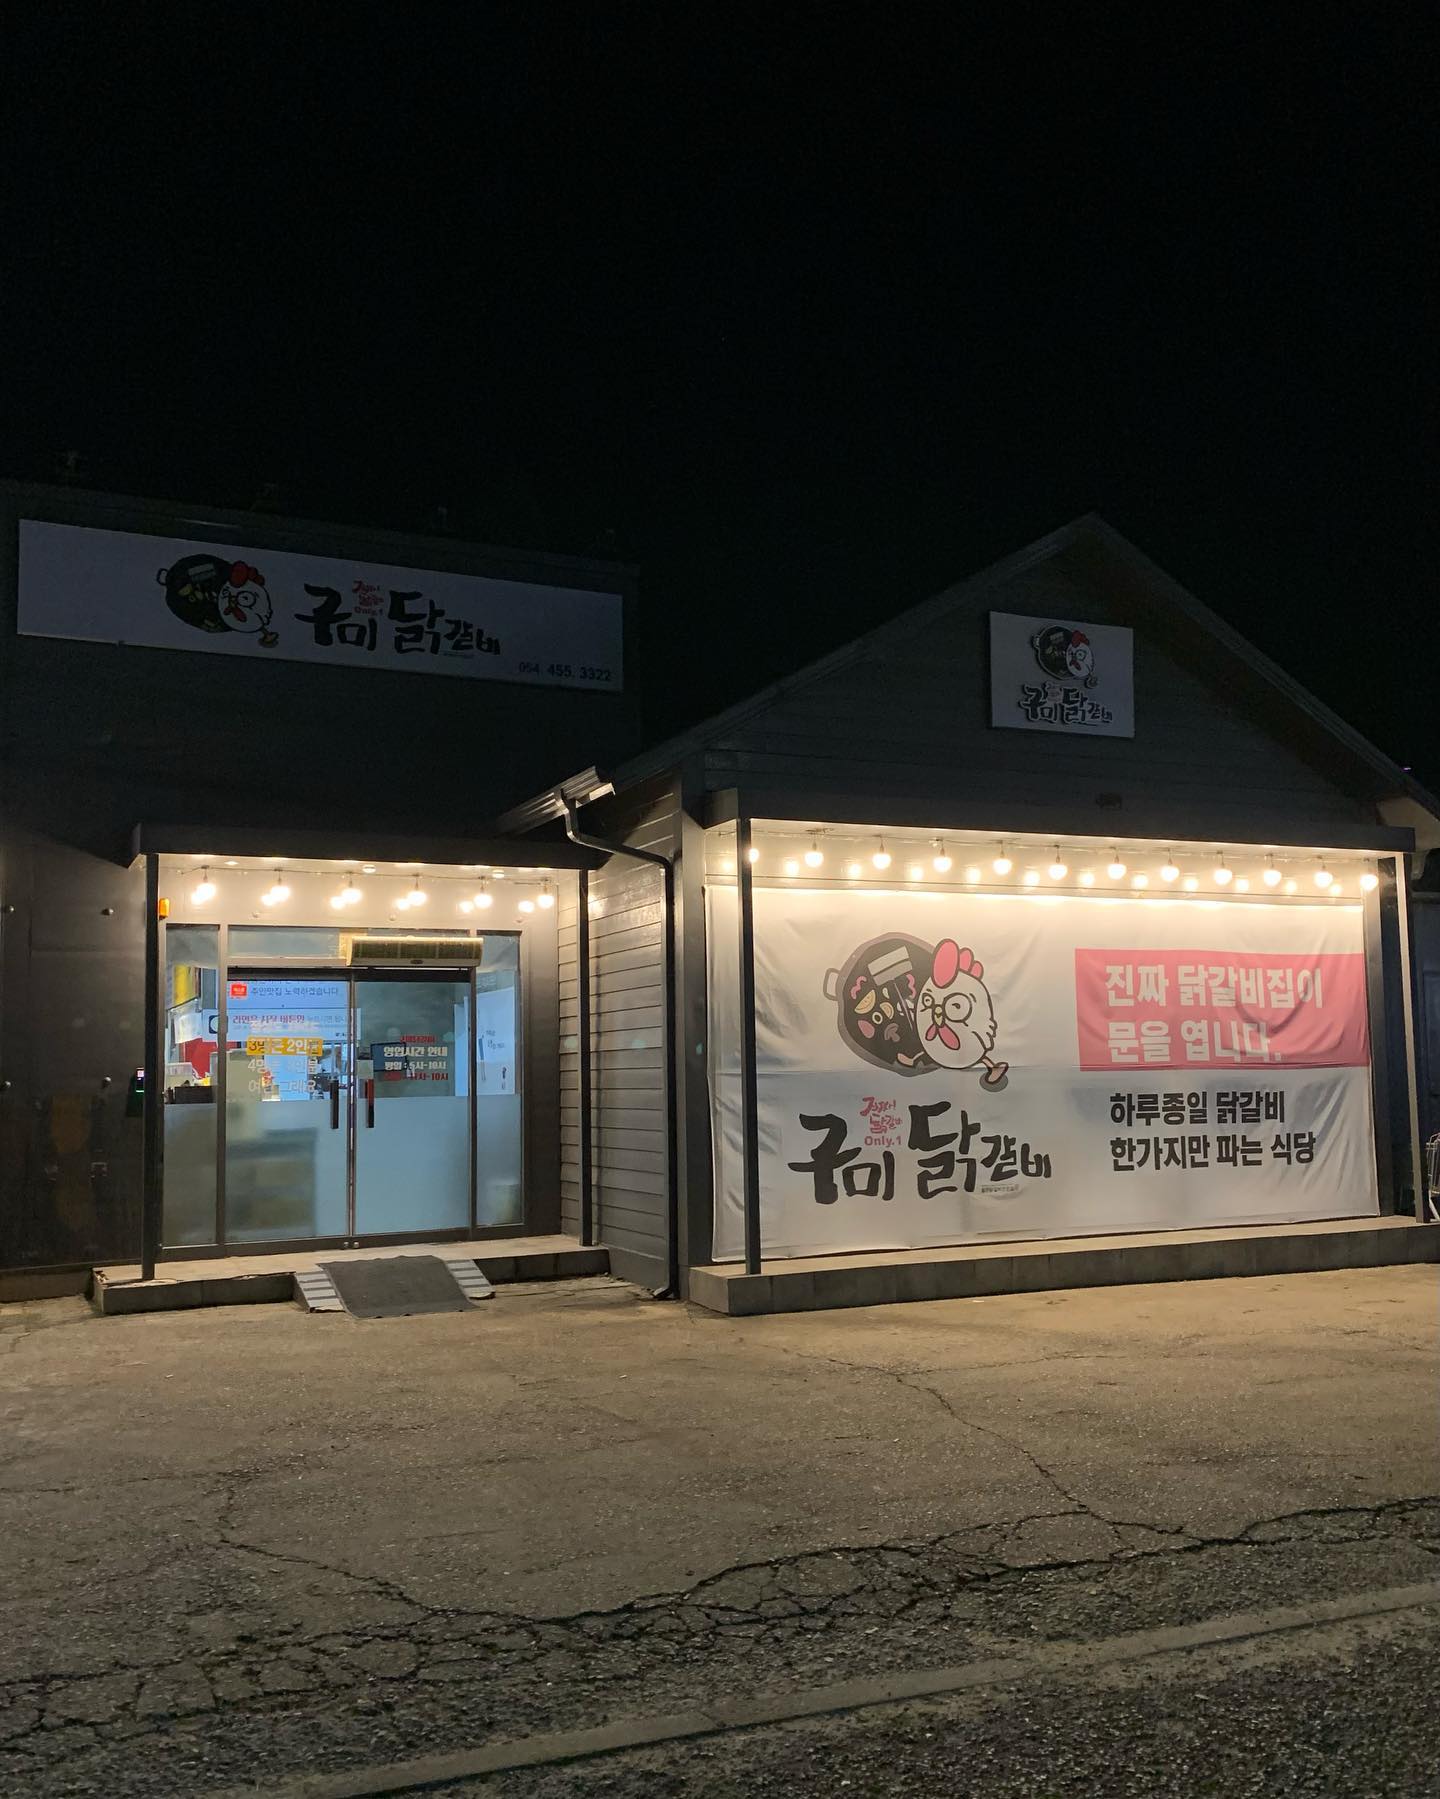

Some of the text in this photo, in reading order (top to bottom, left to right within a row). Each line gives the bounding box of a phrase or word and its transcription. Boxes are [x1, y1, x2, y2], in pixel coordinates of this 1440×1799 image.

[294, 583, 500, 655] 구미 닭갈비
[1105, 964, 1323, 1009] 진짜 닭갈비집이
[1108, 1021, 1171, 1062] 문을
[1110, 1091, 1285, 1126] 하루종일 닭갈비
[788, 1101, 1052, 1204] 구미 닭갈비
[1110, 1131, 1316, 1171] 한가지만 파는 식당
